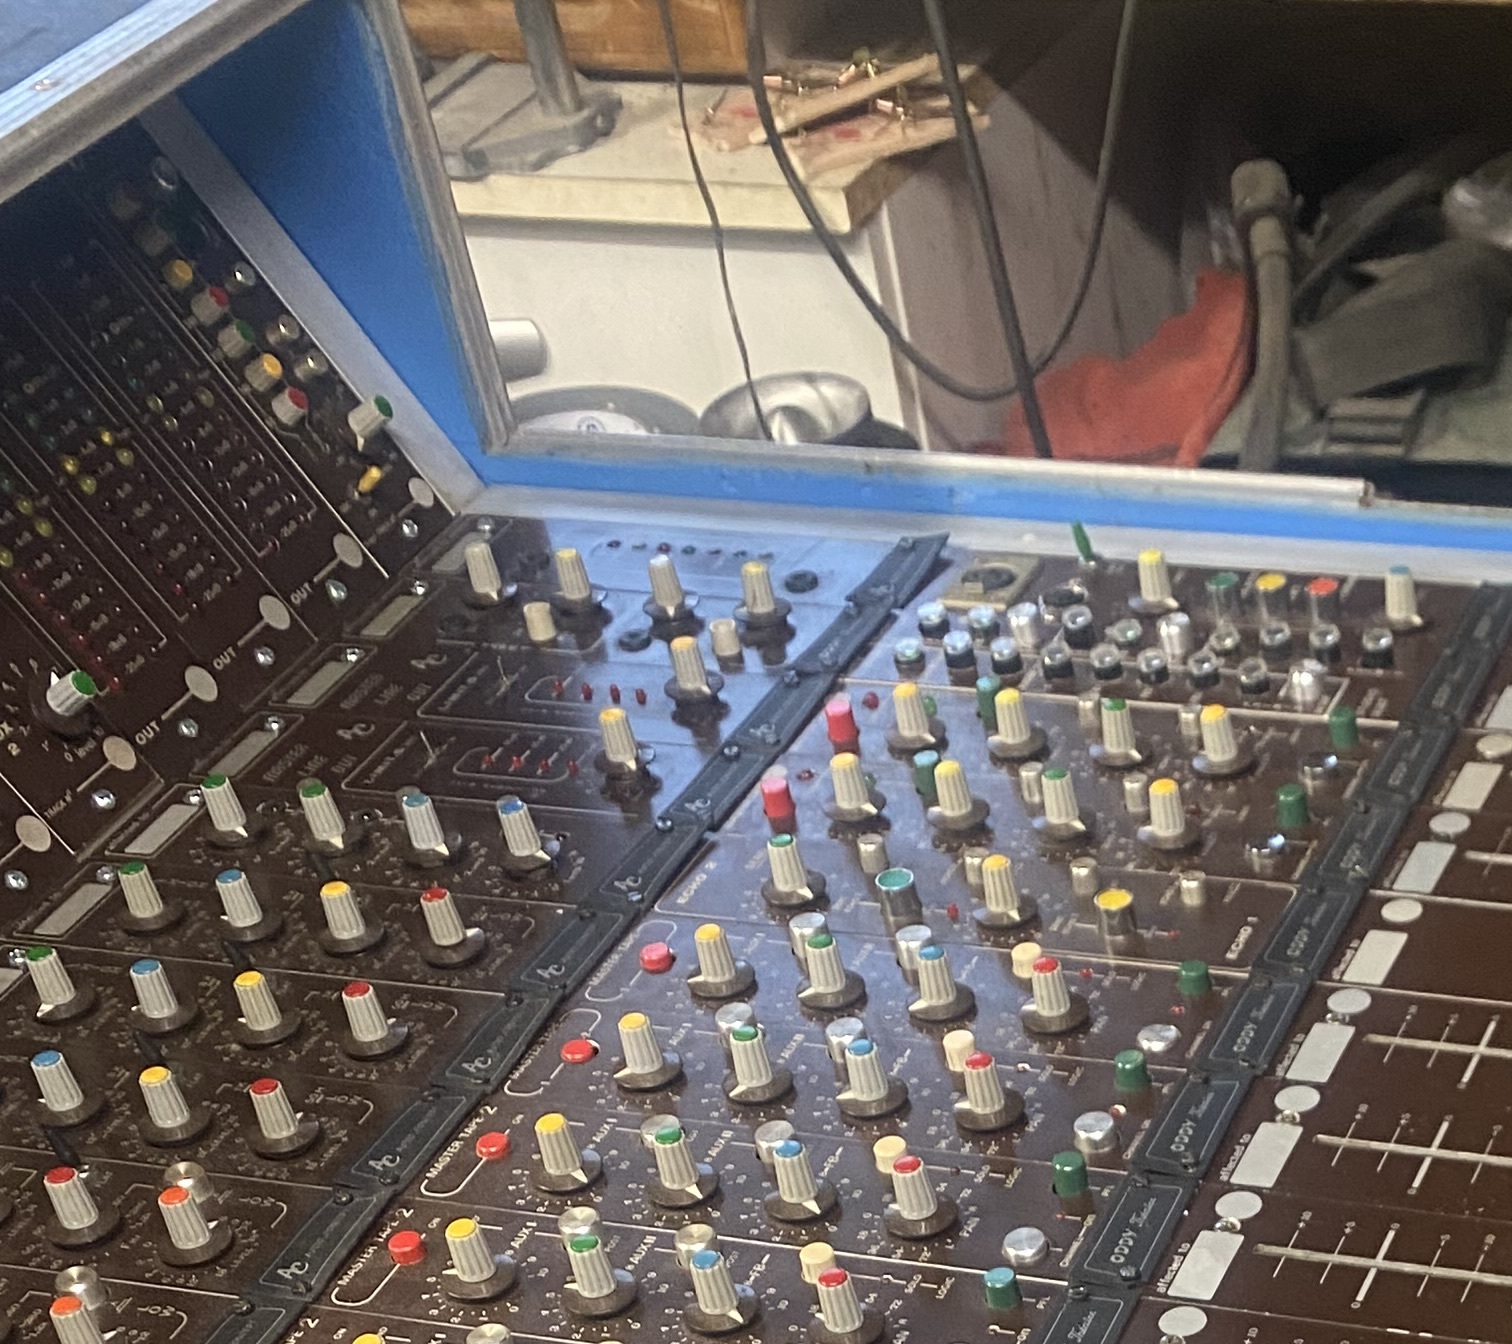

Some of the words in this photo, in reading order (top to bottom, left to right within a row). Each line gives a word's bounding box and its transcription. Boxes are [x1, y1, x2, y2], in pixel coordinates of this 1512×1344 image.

[213, 646, 237, 671] OUT
[135, 720, 161, 746] OUT
[299, 1317, 320, 1330] 2
